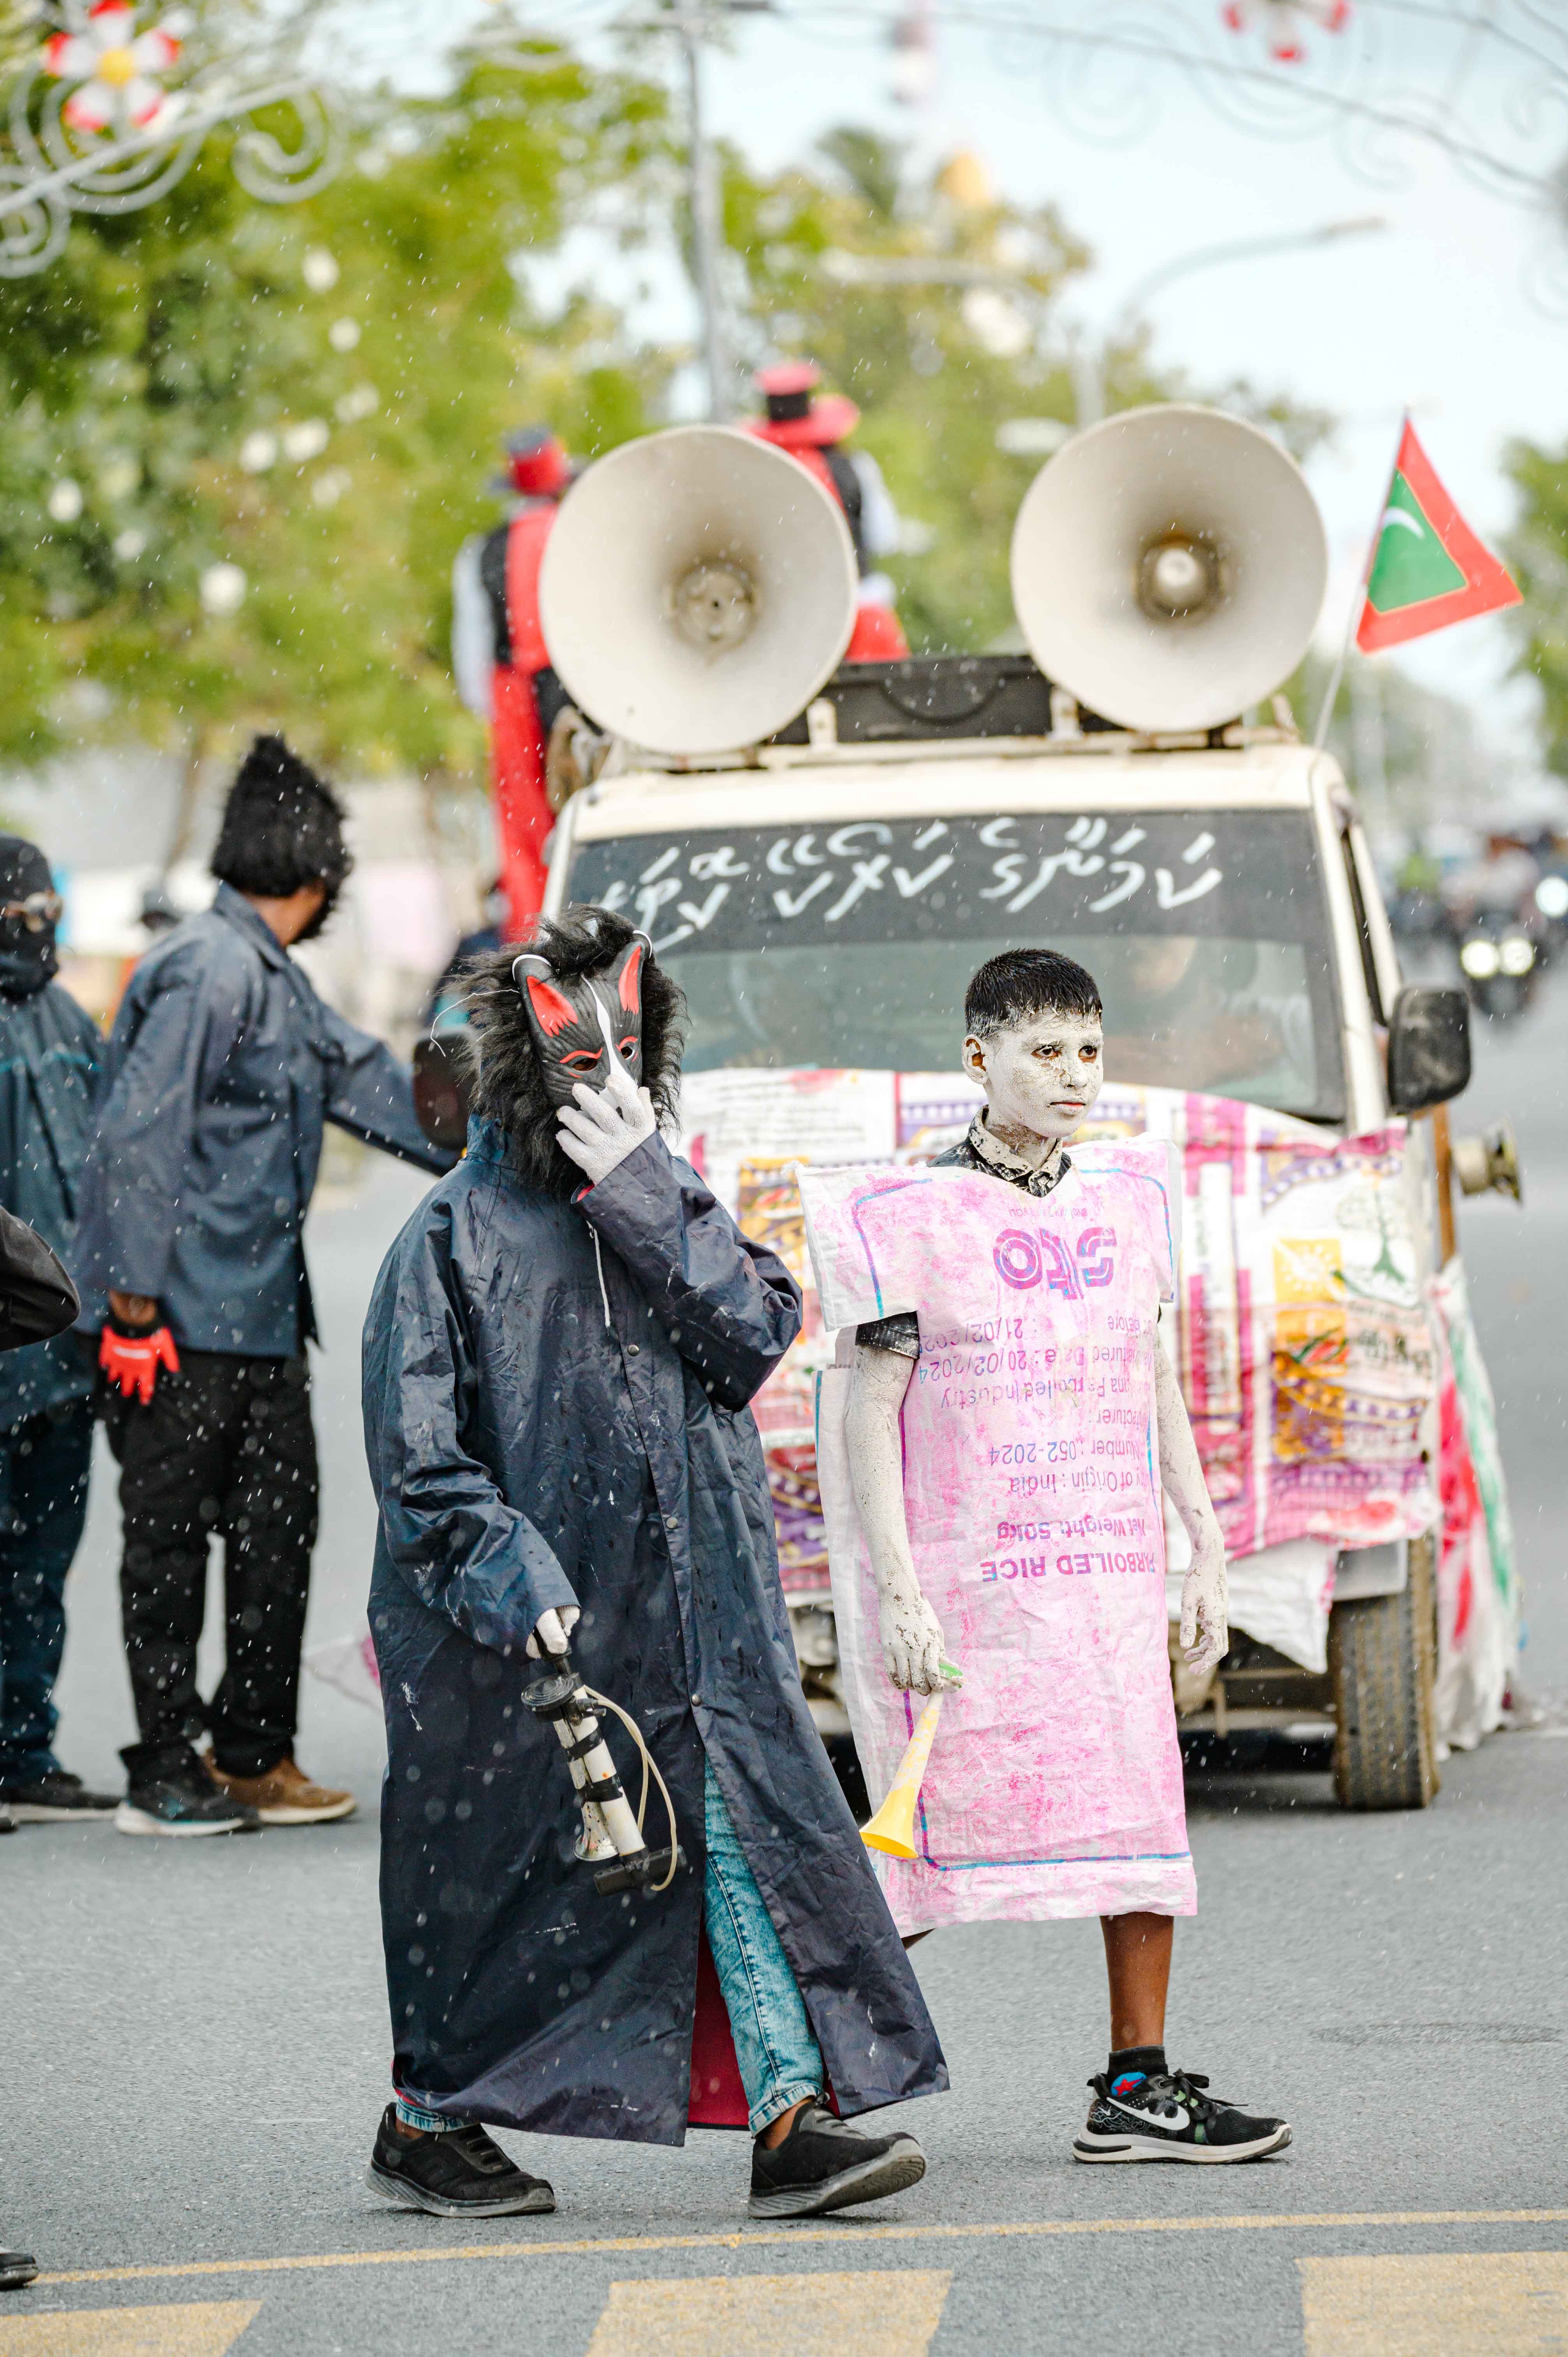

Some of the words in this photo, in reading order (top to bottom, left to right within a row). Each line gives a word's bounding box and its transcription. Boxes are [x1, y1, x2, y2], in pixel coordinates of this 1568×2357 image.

[918, 1347, 1027, 1385] 20/02/2024
[1045, 1346, 1084, 1366] Dae
[941, 1383, 1019, 1410] Industry
[989, 1440, 1076, 1467] 052-2024
[1091, 1440, 1140, 1460] Number
[1010, 1474, 1057, 1495] India
[1072, 1466, 1118, 1493] Origin
[1120, 1472, 1133, 1491] of
[997, 1521, 1051, 1542] 50kg
[1059, 1514, 1127, 1539] Weight:
[1129, 1519, 1145, 1537] Net
[979, 1556, 1046, 1583] RICE
